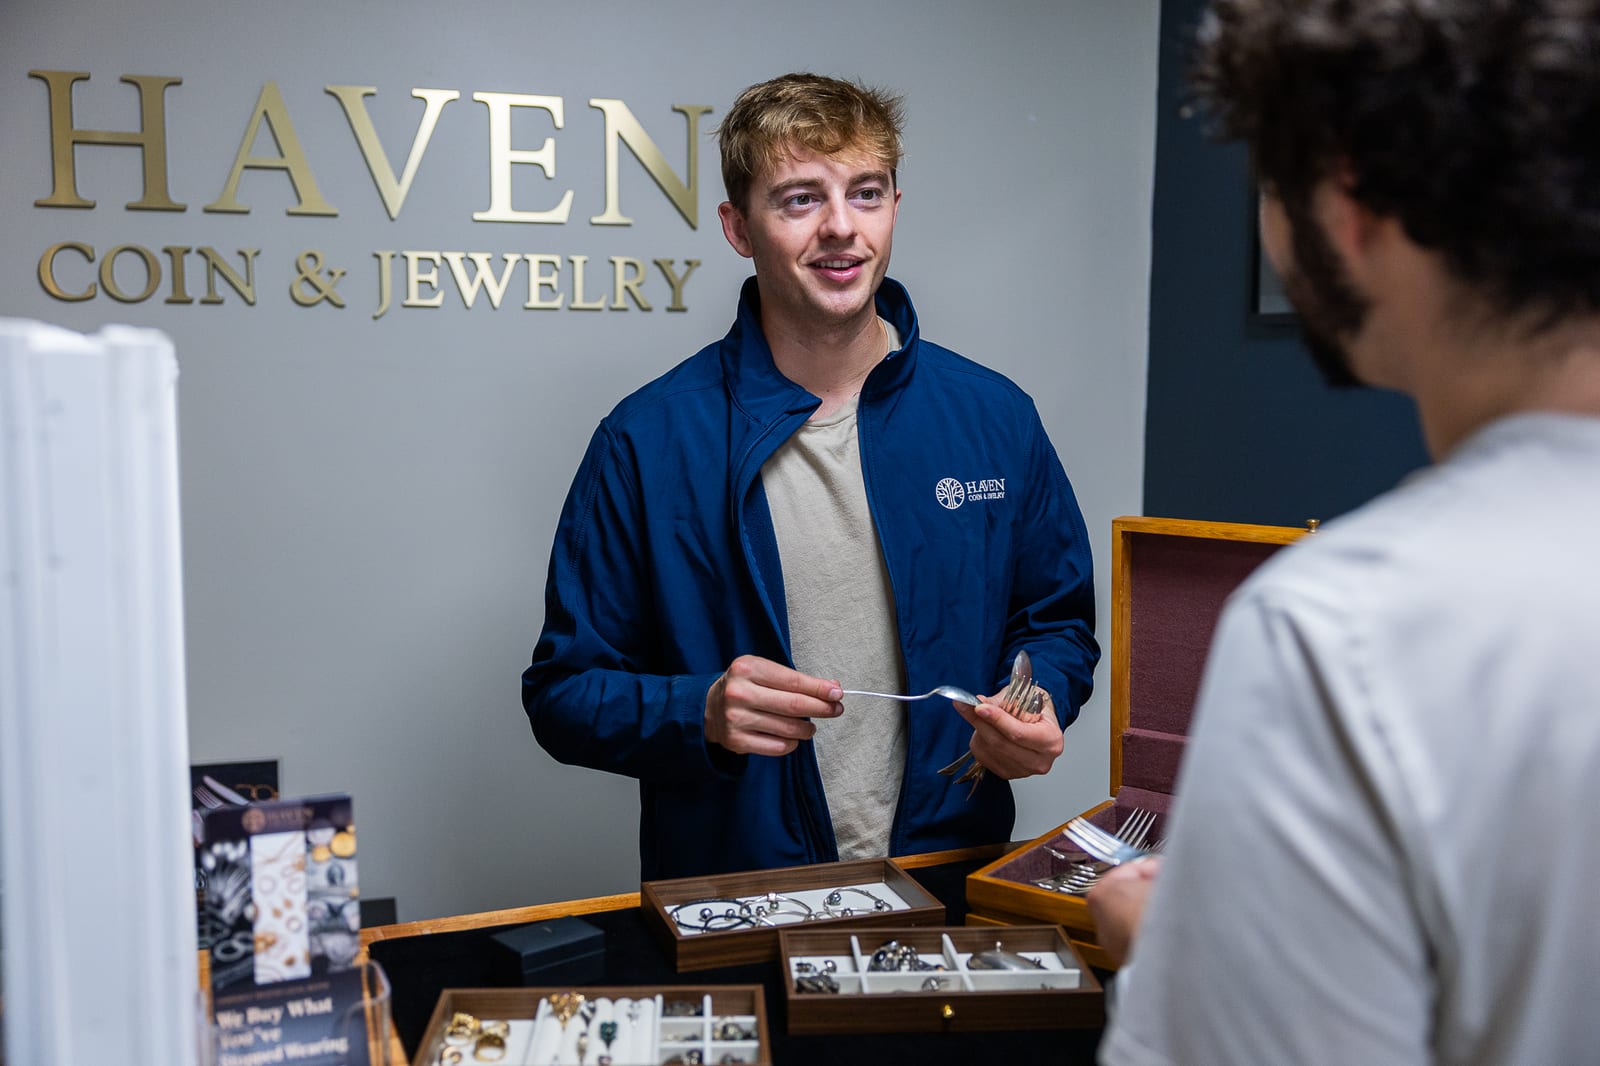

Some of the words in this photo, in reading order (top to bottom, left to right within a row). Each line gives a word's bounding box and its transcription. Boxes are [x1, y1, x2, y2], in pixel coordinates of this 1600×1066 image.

[28, 69, 713, 231] HAVEN
[38, 242, 262, 305] COIN
[289, 249, 347, 308] &
[372, 249, 702, 320] JEWELRY
[965, 478, 1005, 494] HAVEN
[968, 493, 983, 502] COIN
[216, 1011, 243, 1029] We
[246, 1006, 283, 1025] Buy
[287, 997, 332, 1017] What
[284, 1037, 348, 1058] Wearing
